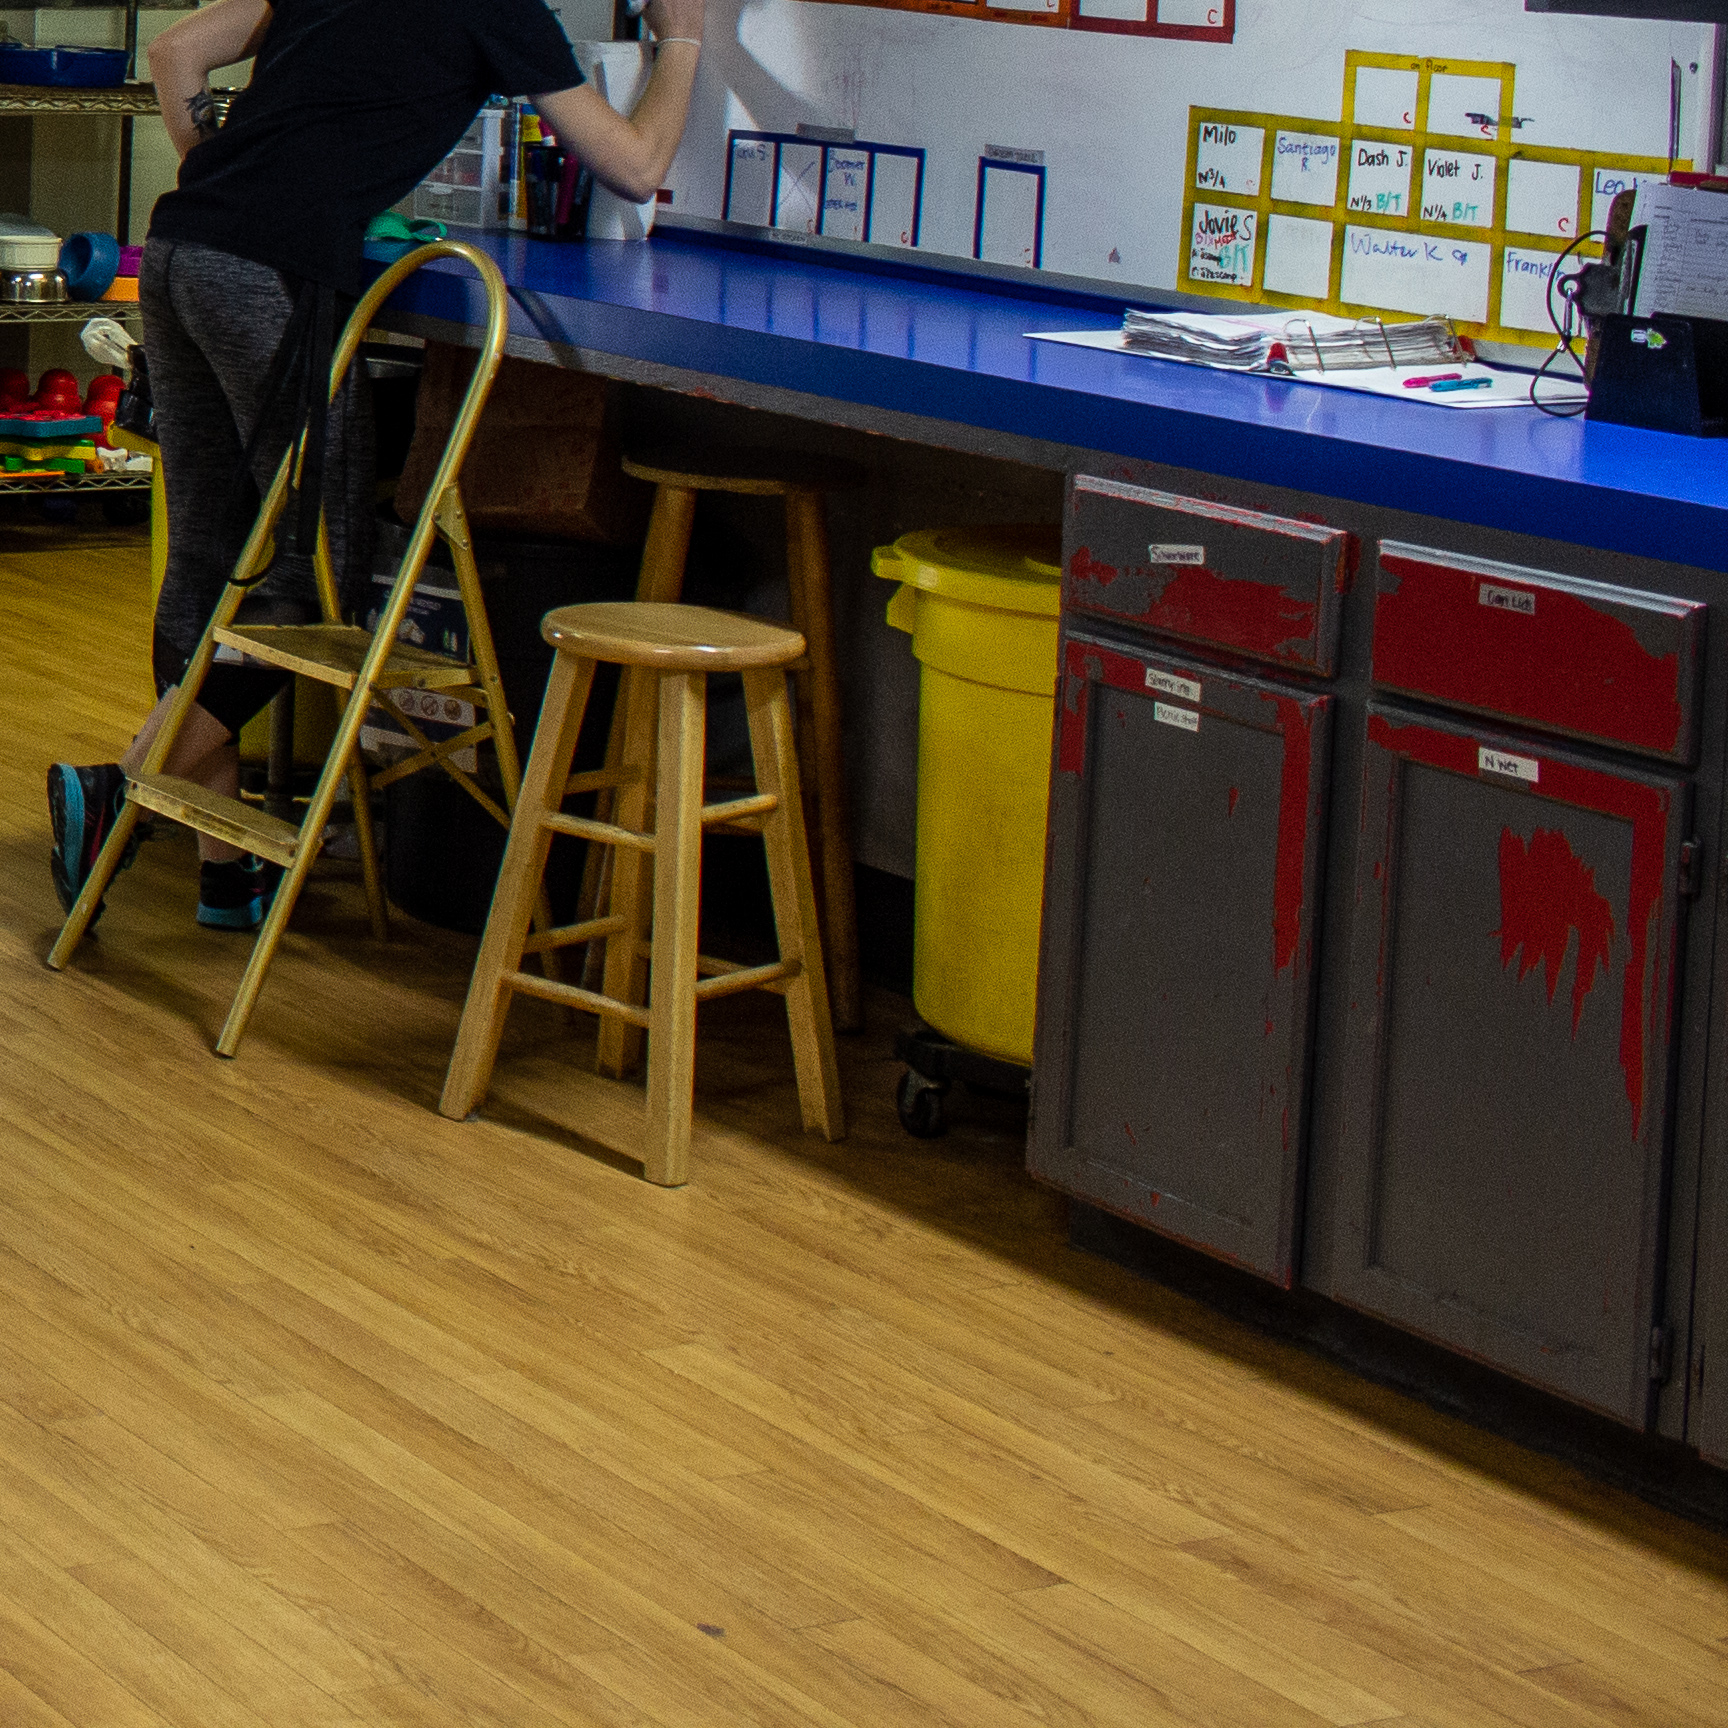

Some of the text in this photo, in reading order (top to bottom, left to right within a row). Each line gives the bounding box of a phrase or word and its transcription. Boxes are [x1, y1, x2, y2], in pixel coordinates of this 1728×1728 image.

[1203, 125, 1236, 146] Milo
[1277, 137, 1336, 165] Santiago
[1358, 148, 1389, 167] Dash
[1428, 158, 1460, 178] Violet
[1596, 171, 1625, 196] Leo
[1199, 210, 1238, 235] Jovie
[1351, 232, 1443, 262] Walter K
[1506, 251, 1566, 281] Frankln
